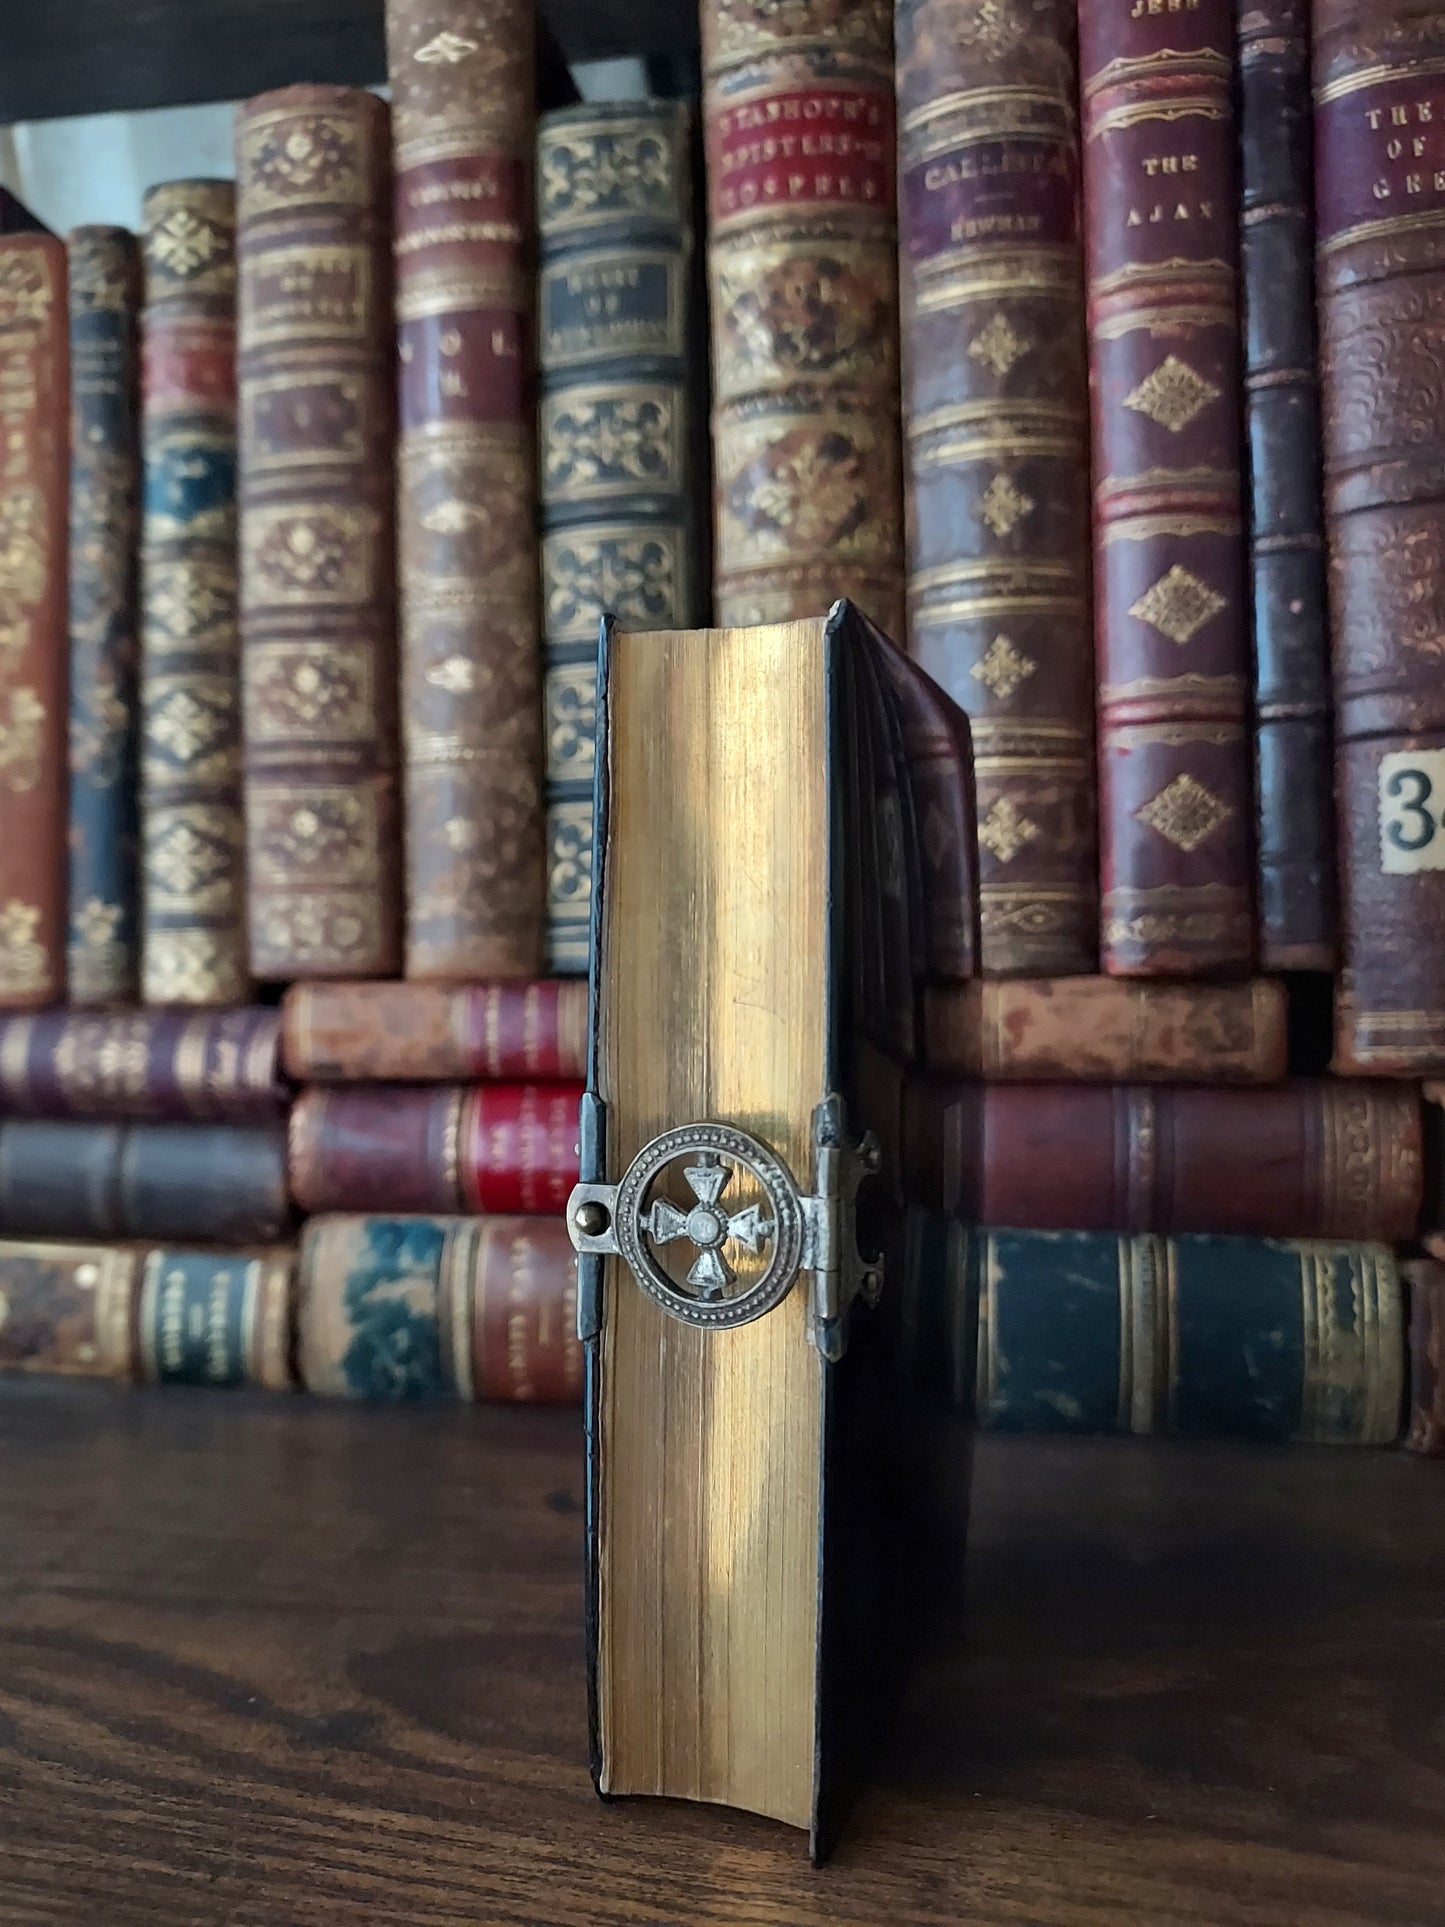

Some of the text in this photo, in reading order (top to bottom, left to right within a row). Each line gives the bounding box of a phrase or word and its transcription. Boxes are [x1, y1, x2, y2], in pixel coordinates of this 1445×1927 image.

[1364, 100, 1445, 130] THE
[1386, 135, 1427, 161] OF
[1141, 153, 1201, 178] THE
[1125, 200, 1215, 228] AJAX
[1387, 768, 1445, 851] 3
